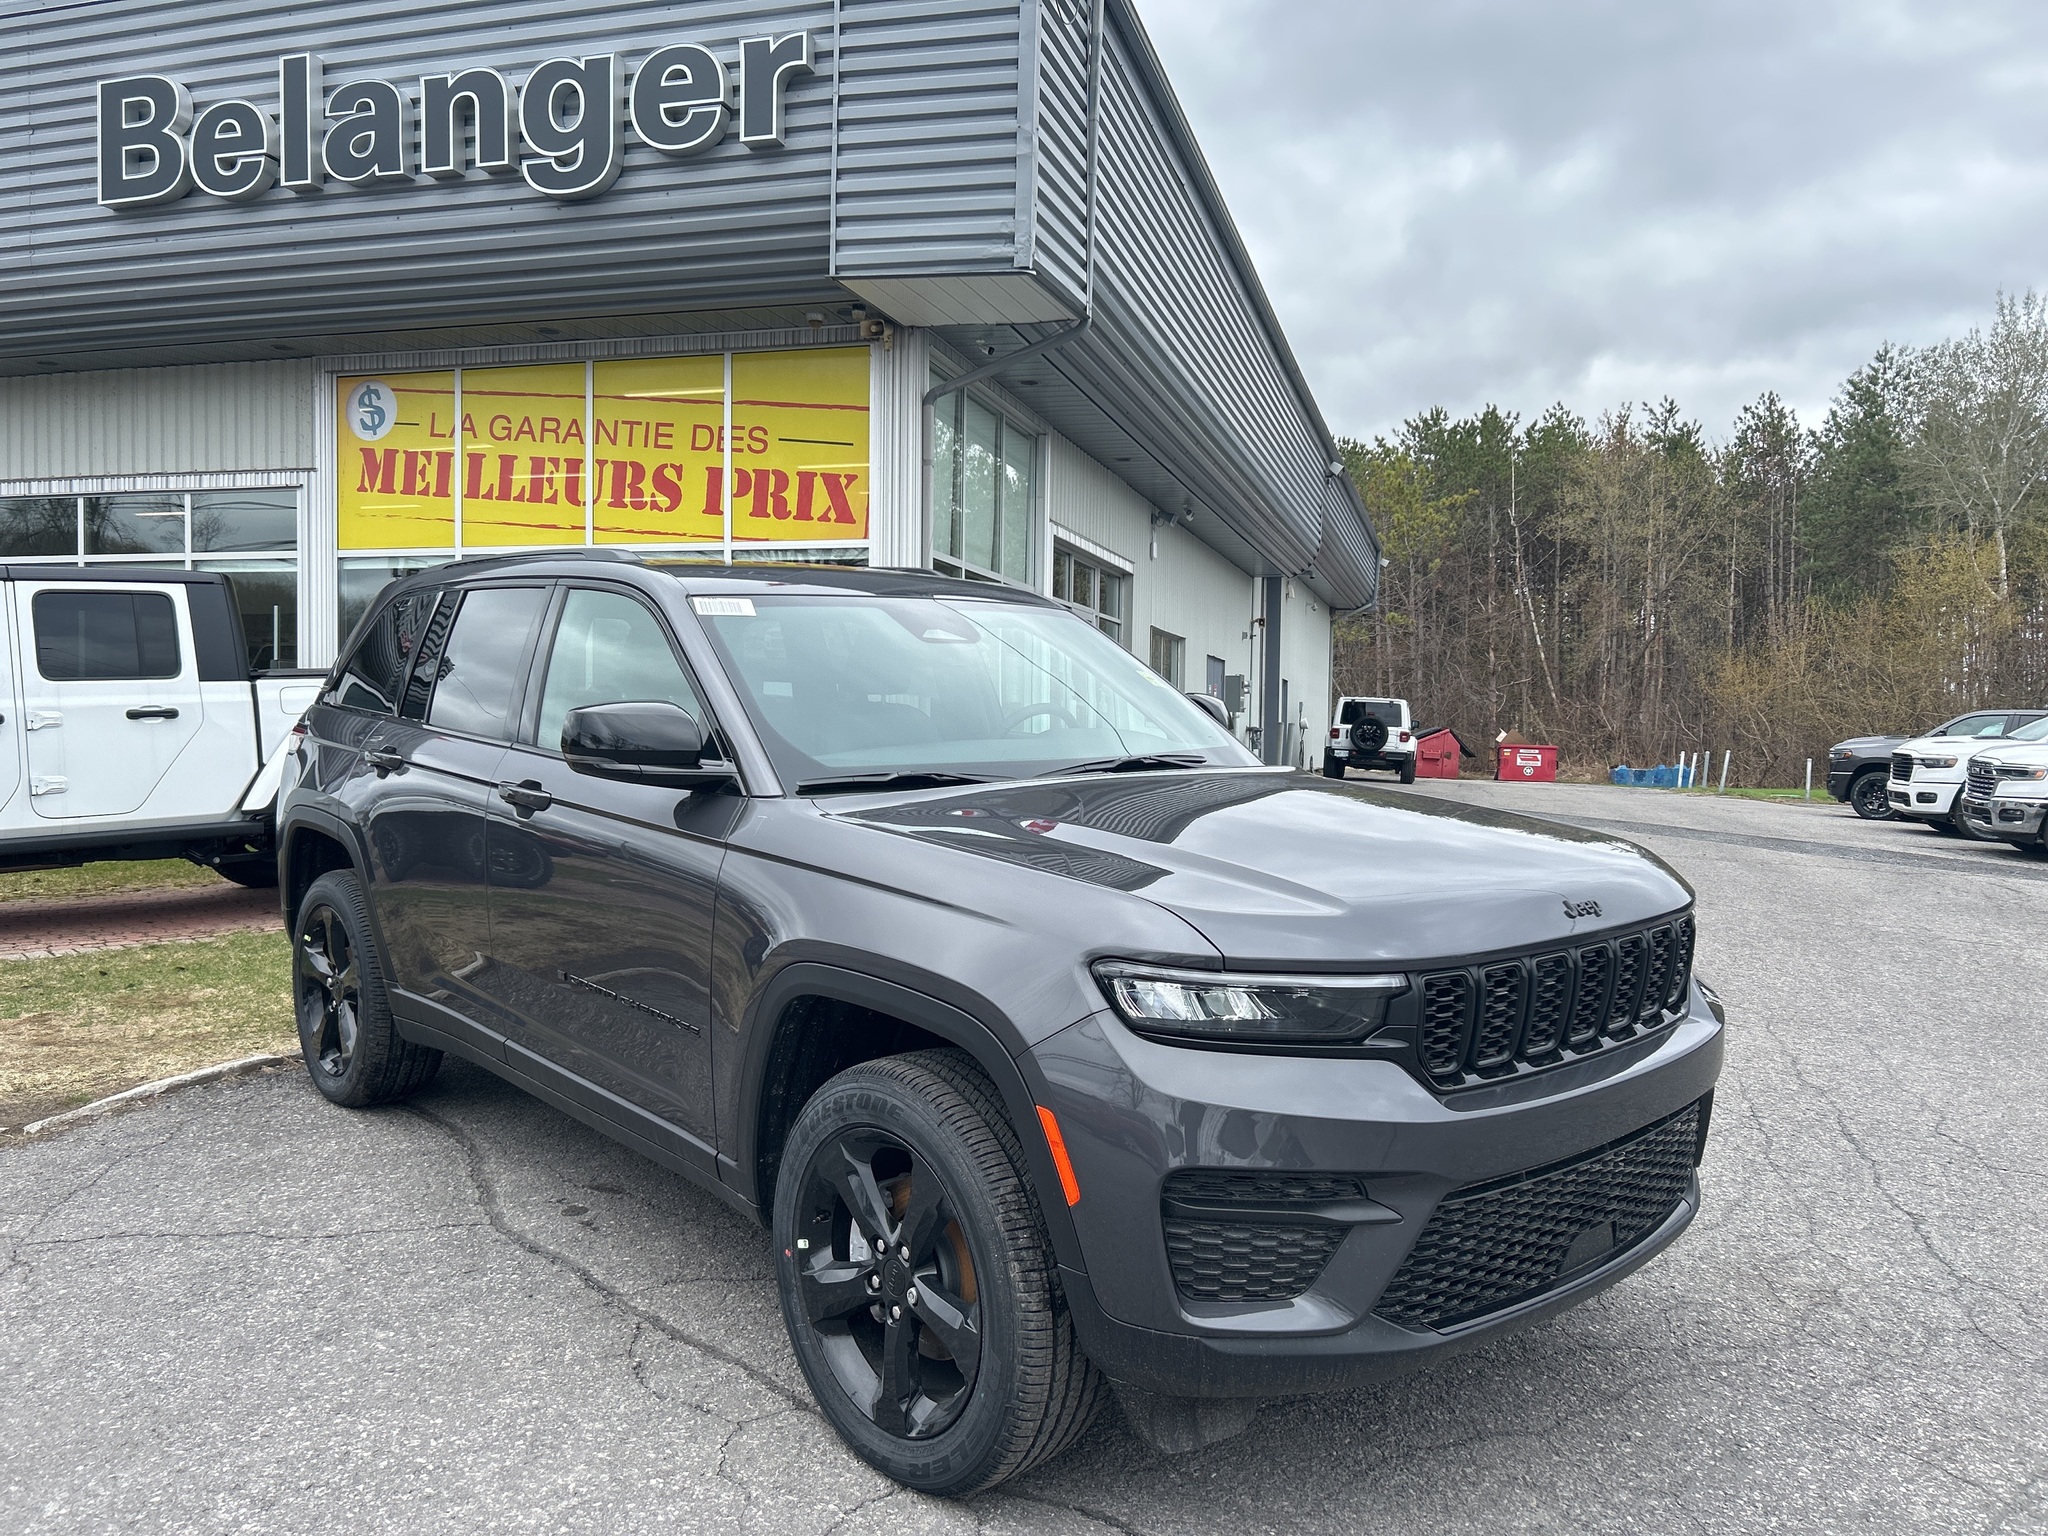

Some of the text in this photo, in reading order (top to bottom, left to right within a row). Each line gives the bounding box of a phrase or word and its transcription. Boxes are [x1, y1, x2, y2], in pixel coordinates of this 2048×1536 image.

[97, 29, 814, 207] Belanger
[429, 411, 769, 454] LA GARANTIE DES
[356, 447, 859, 525] MEILLEURS PRIX
[1563, 900, 1602, 919] Jeep
